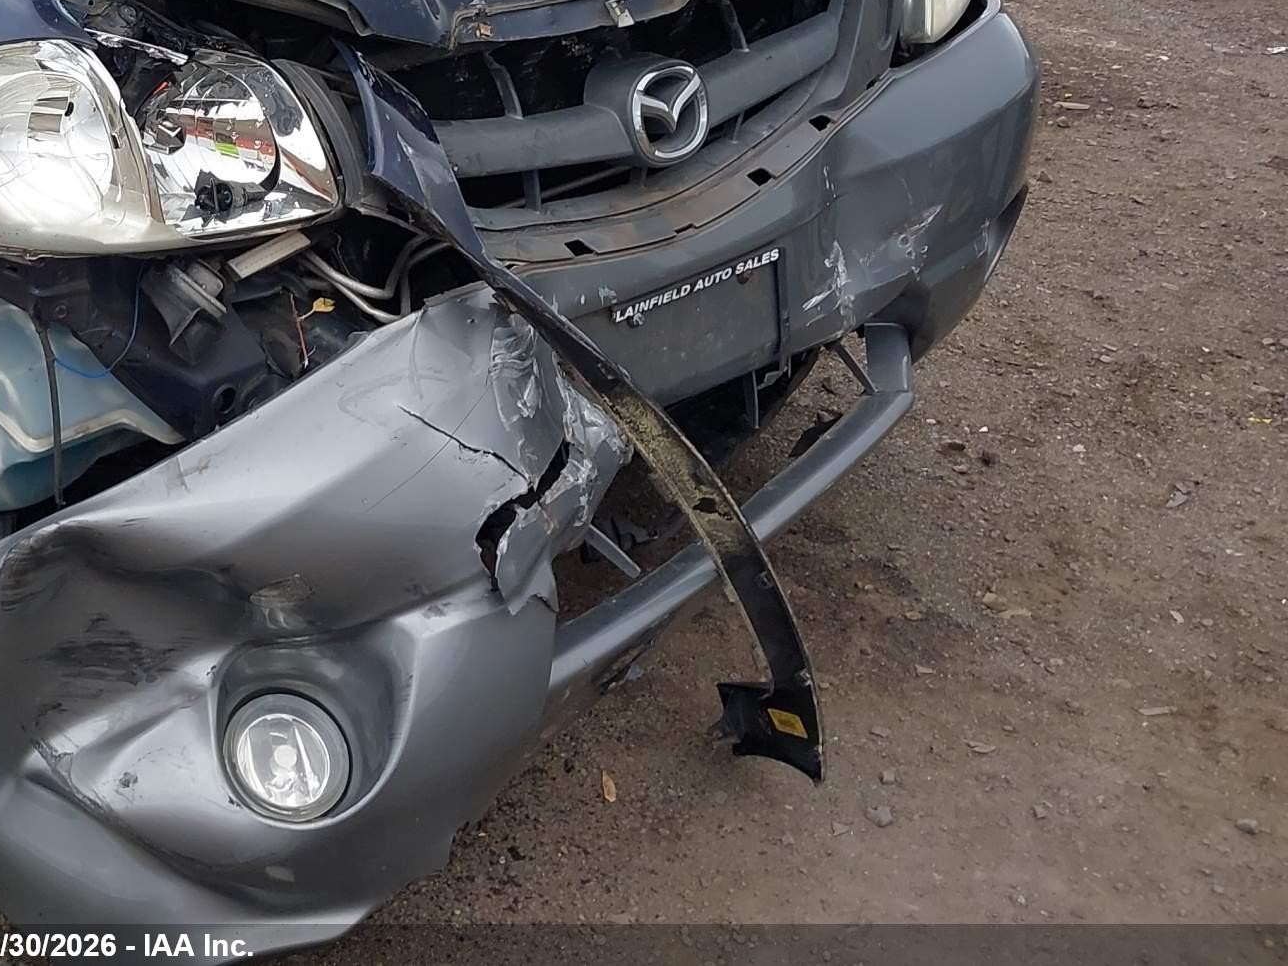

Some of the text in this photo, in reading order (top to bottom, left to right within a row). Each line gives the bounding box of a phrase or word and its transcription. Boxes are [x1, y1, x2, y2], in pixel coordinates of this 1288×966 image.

[612, 248, 780, 323] LAINFIELD AUTO SALES
